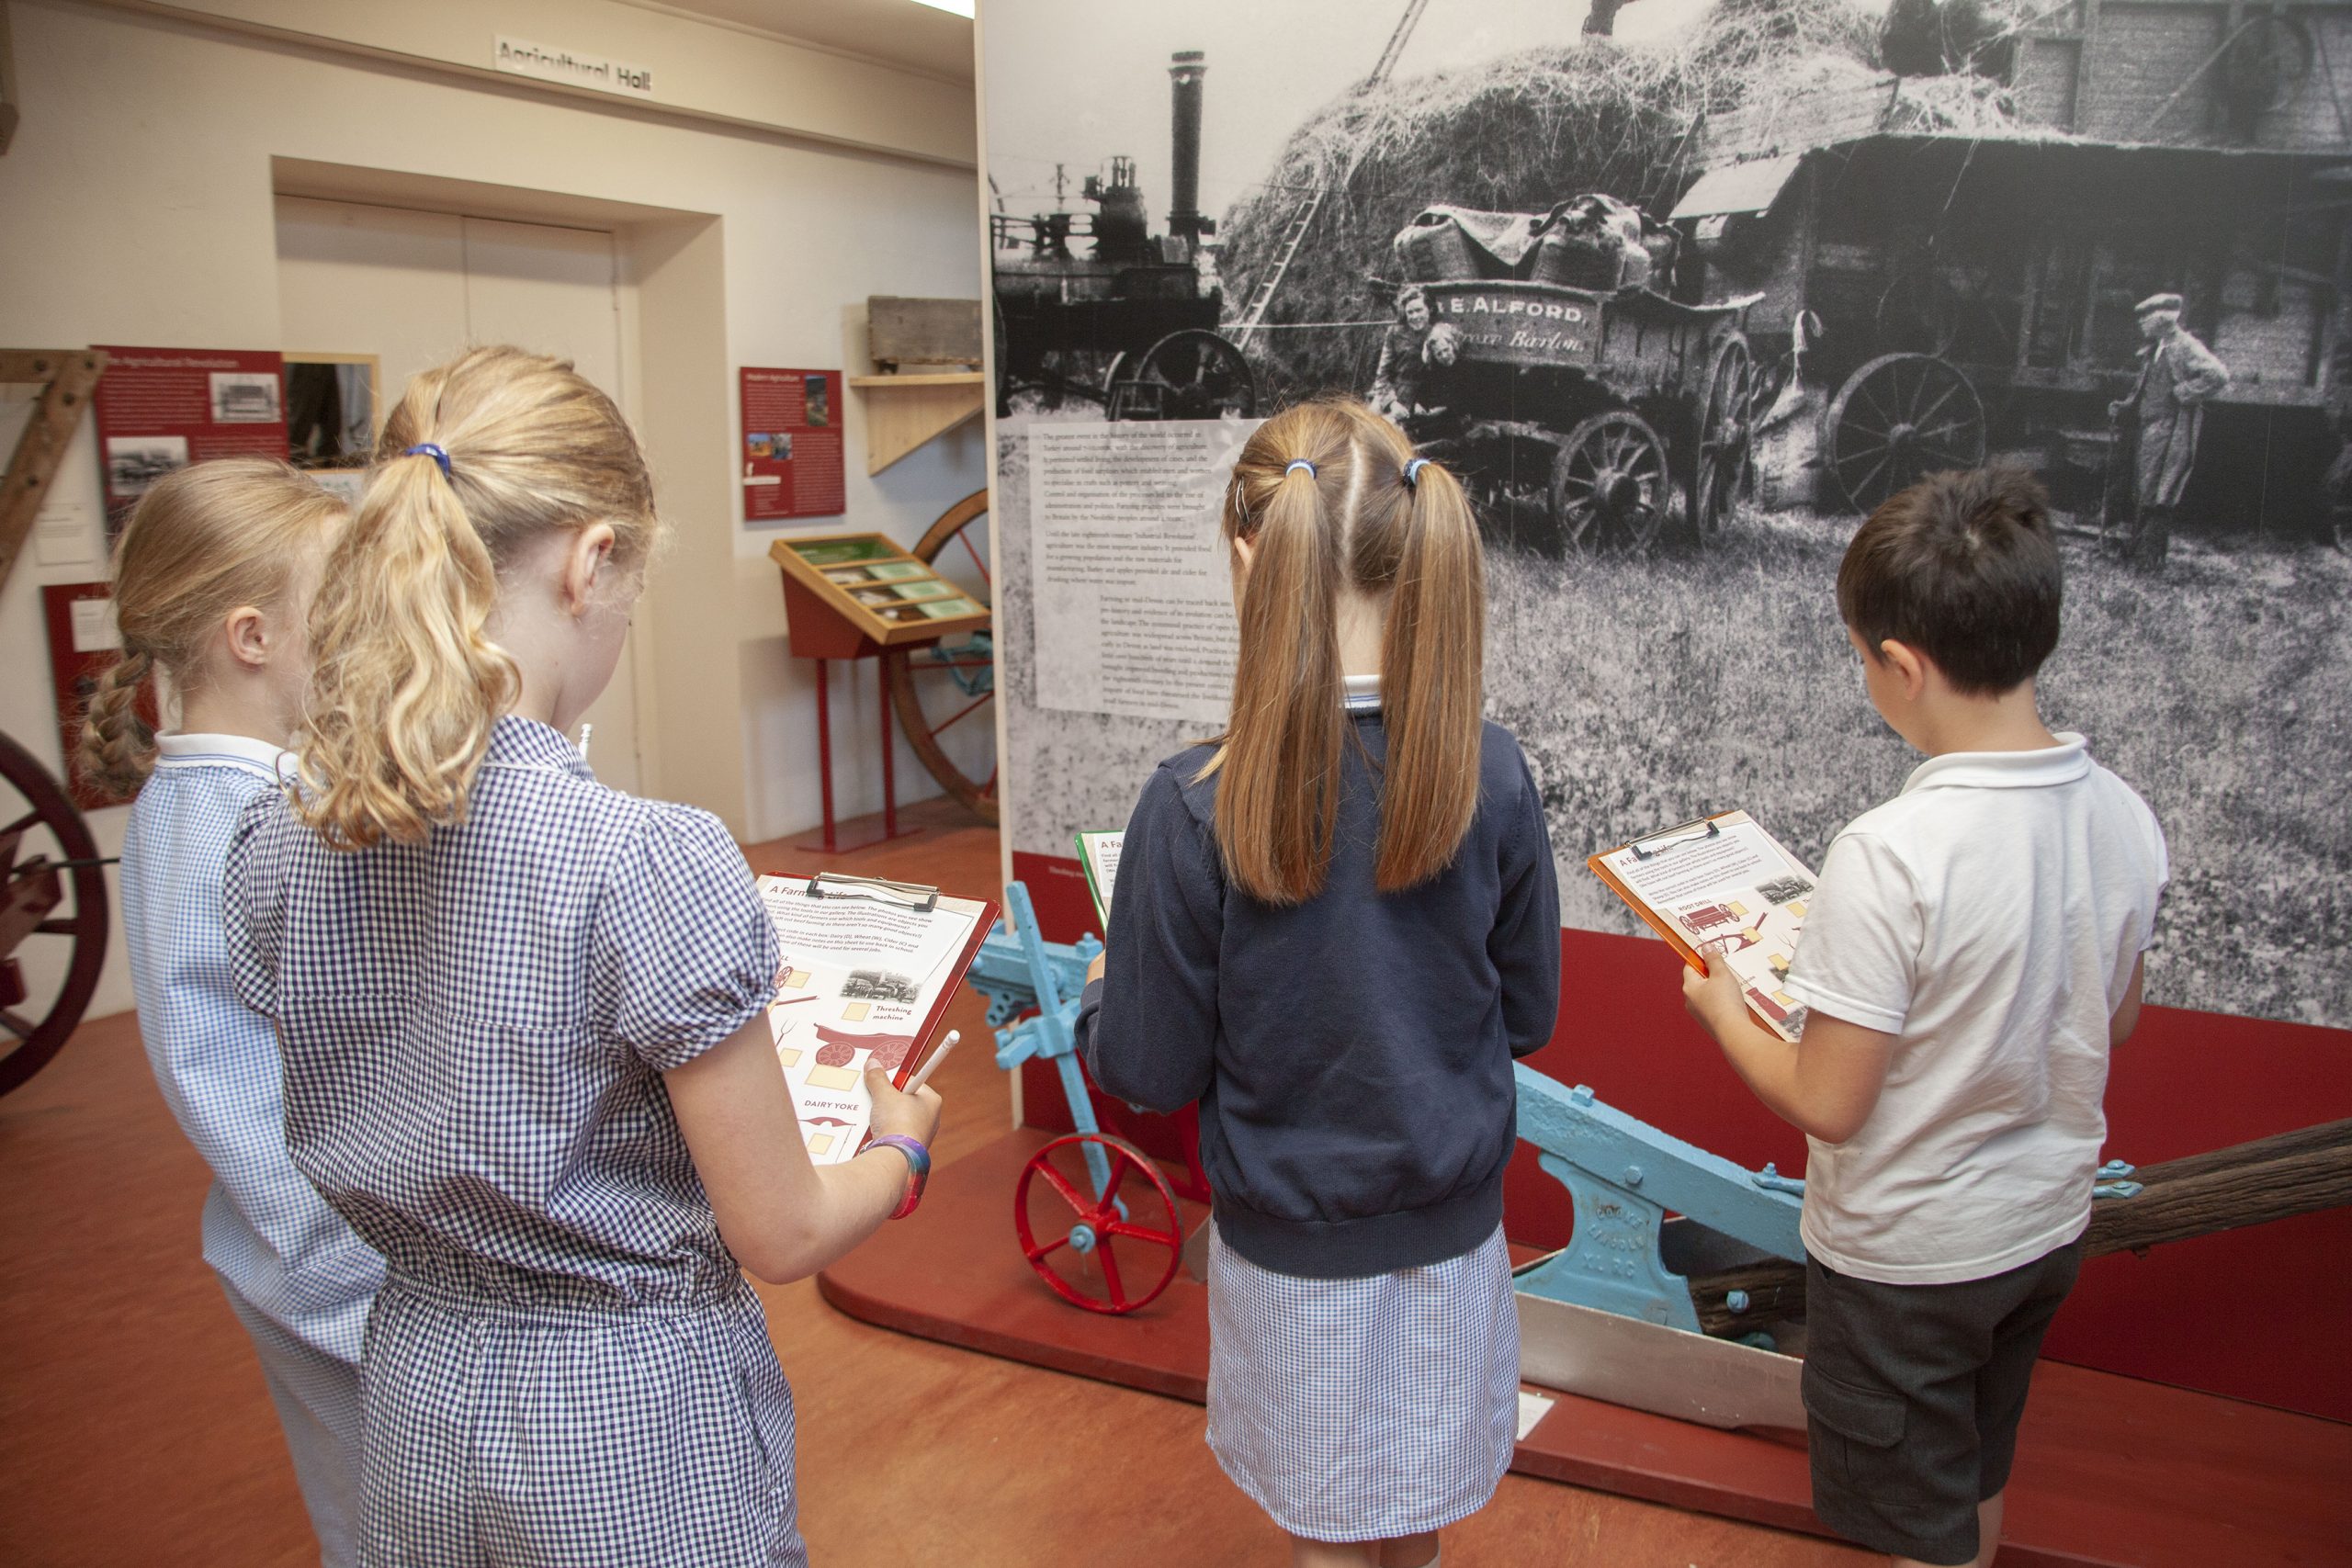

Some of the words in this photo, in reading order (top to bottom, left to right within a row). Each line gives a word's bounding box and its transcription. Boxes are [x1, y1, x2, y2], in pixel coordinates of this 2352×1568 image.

[500, 42, 608, 82] Agricultural
[876, 1005, 912, 1016] Threshing
[805, 1100, 832, 1109] DAIRY
[835, 1102, 860, 1111] YOKE
